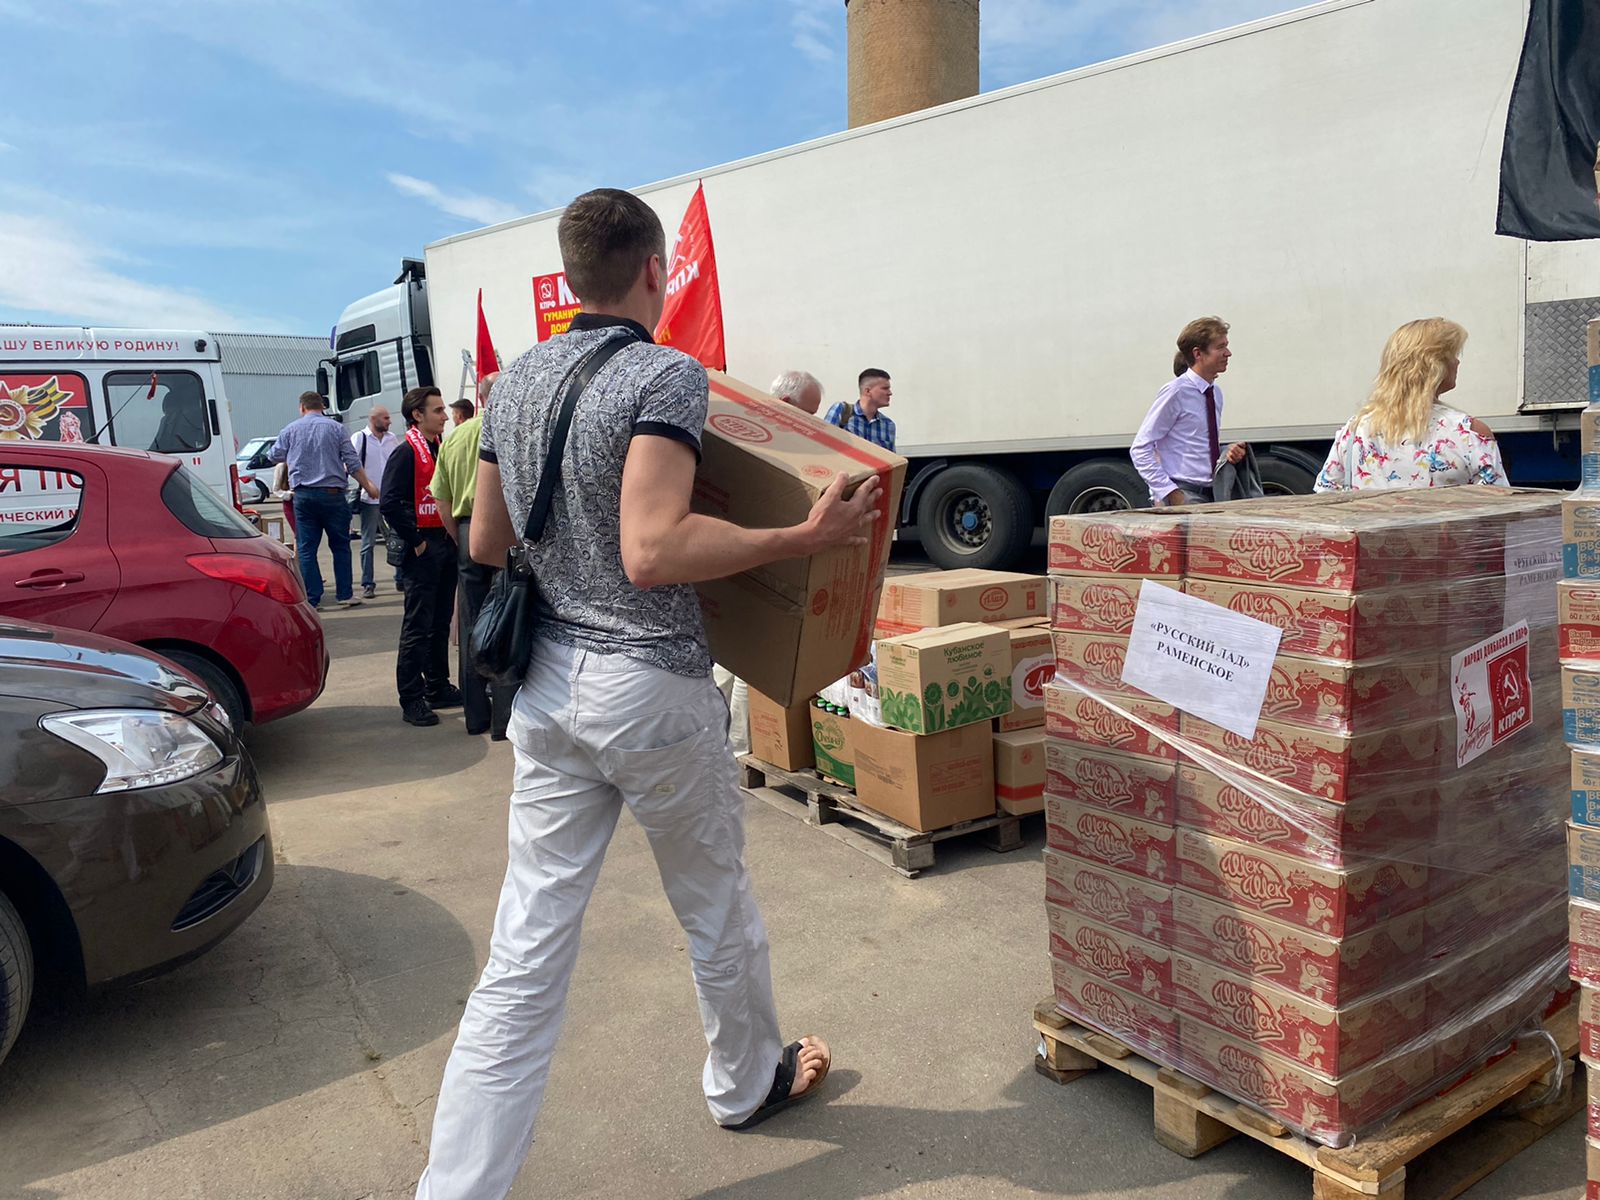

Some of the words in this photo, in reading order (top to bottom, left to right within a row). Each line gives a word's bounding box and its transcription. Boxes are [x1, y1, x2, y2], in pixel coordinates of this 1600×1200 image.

[0, 340, 27, 351] ШУ
[33, 340, 110, 350] ВЕЛИКУЮ
[114, 340, 180, 352] РОДИНУ!
[944, 642, 985, 657] Кубанское
[1151, 622, 1215, 654] «РУССКИЙ
[1216, 647, 1250, 669] ЛАД»
[947, 651, 983, 665] любимое
[1157, 641, 1235, 682] РАМЕНСКОЕ
[1498, 706, 1526, 734] КПРФ
